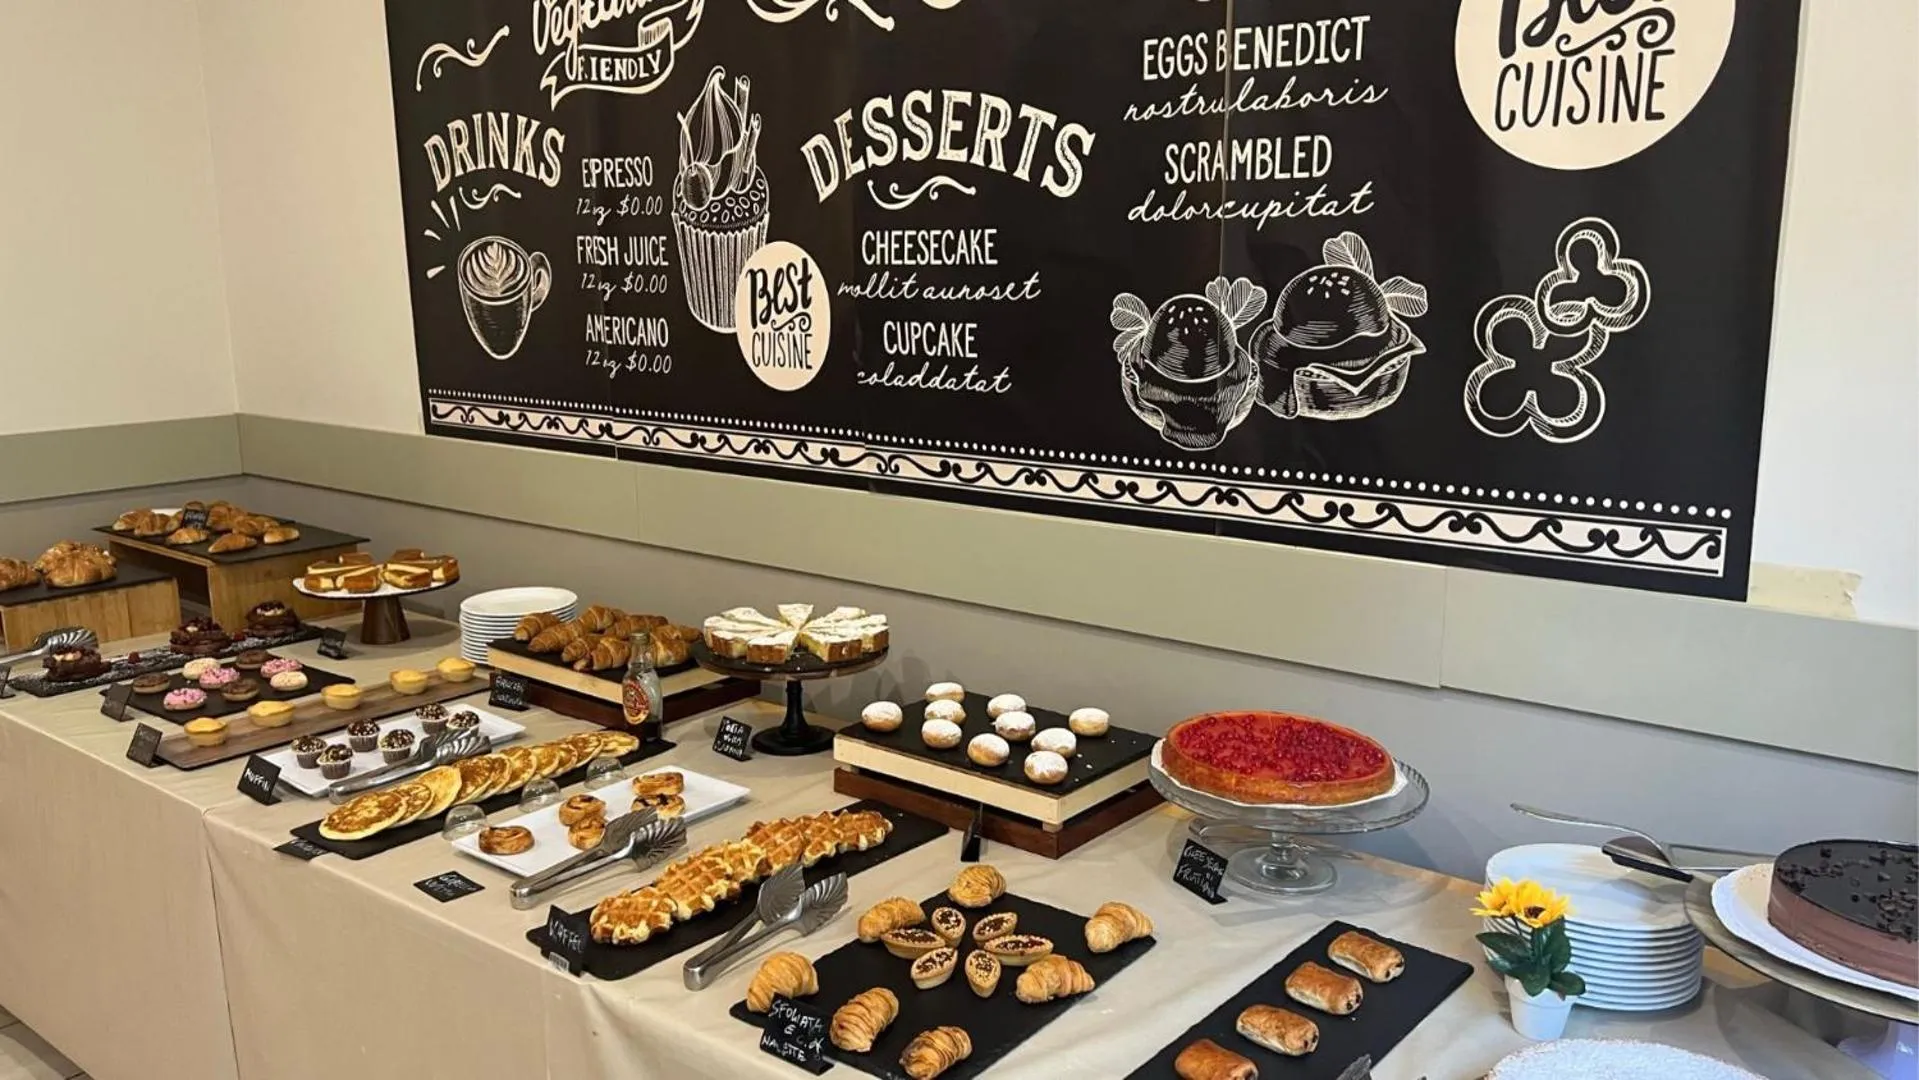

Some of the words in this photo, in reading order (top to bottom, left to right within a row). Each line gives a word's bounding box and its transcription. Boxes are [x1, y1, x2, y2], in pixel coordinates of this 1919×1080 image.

[1143, 32, 1209, 81] EGGS
[1215, 14, 1371, 75] BENEDICT
[1494, 48, 1676, 132] CUISINE
[423, 111, 566, 192] DRINKS
[800, 88, 1096, 203] DESSERTS
[1164, 134, 1333, 187] SCRAMBLED
[616, 193, 663, 217] $0.00
[576, 235, 619, 266] FRESH
[623, 235, 669, 266] JUICE
[861, 228, 998, 266] CHEESECAKE
[621, 271, 668, 294] $0.00
[745, 257, 814, 330] Best
[585, 313, 669, 348] AMERICANO
[883, 320, 978, 358] CUPCAKE
[625, 350, 672, 374] $0.00
[751, 332, 814, 371] CUISINE
